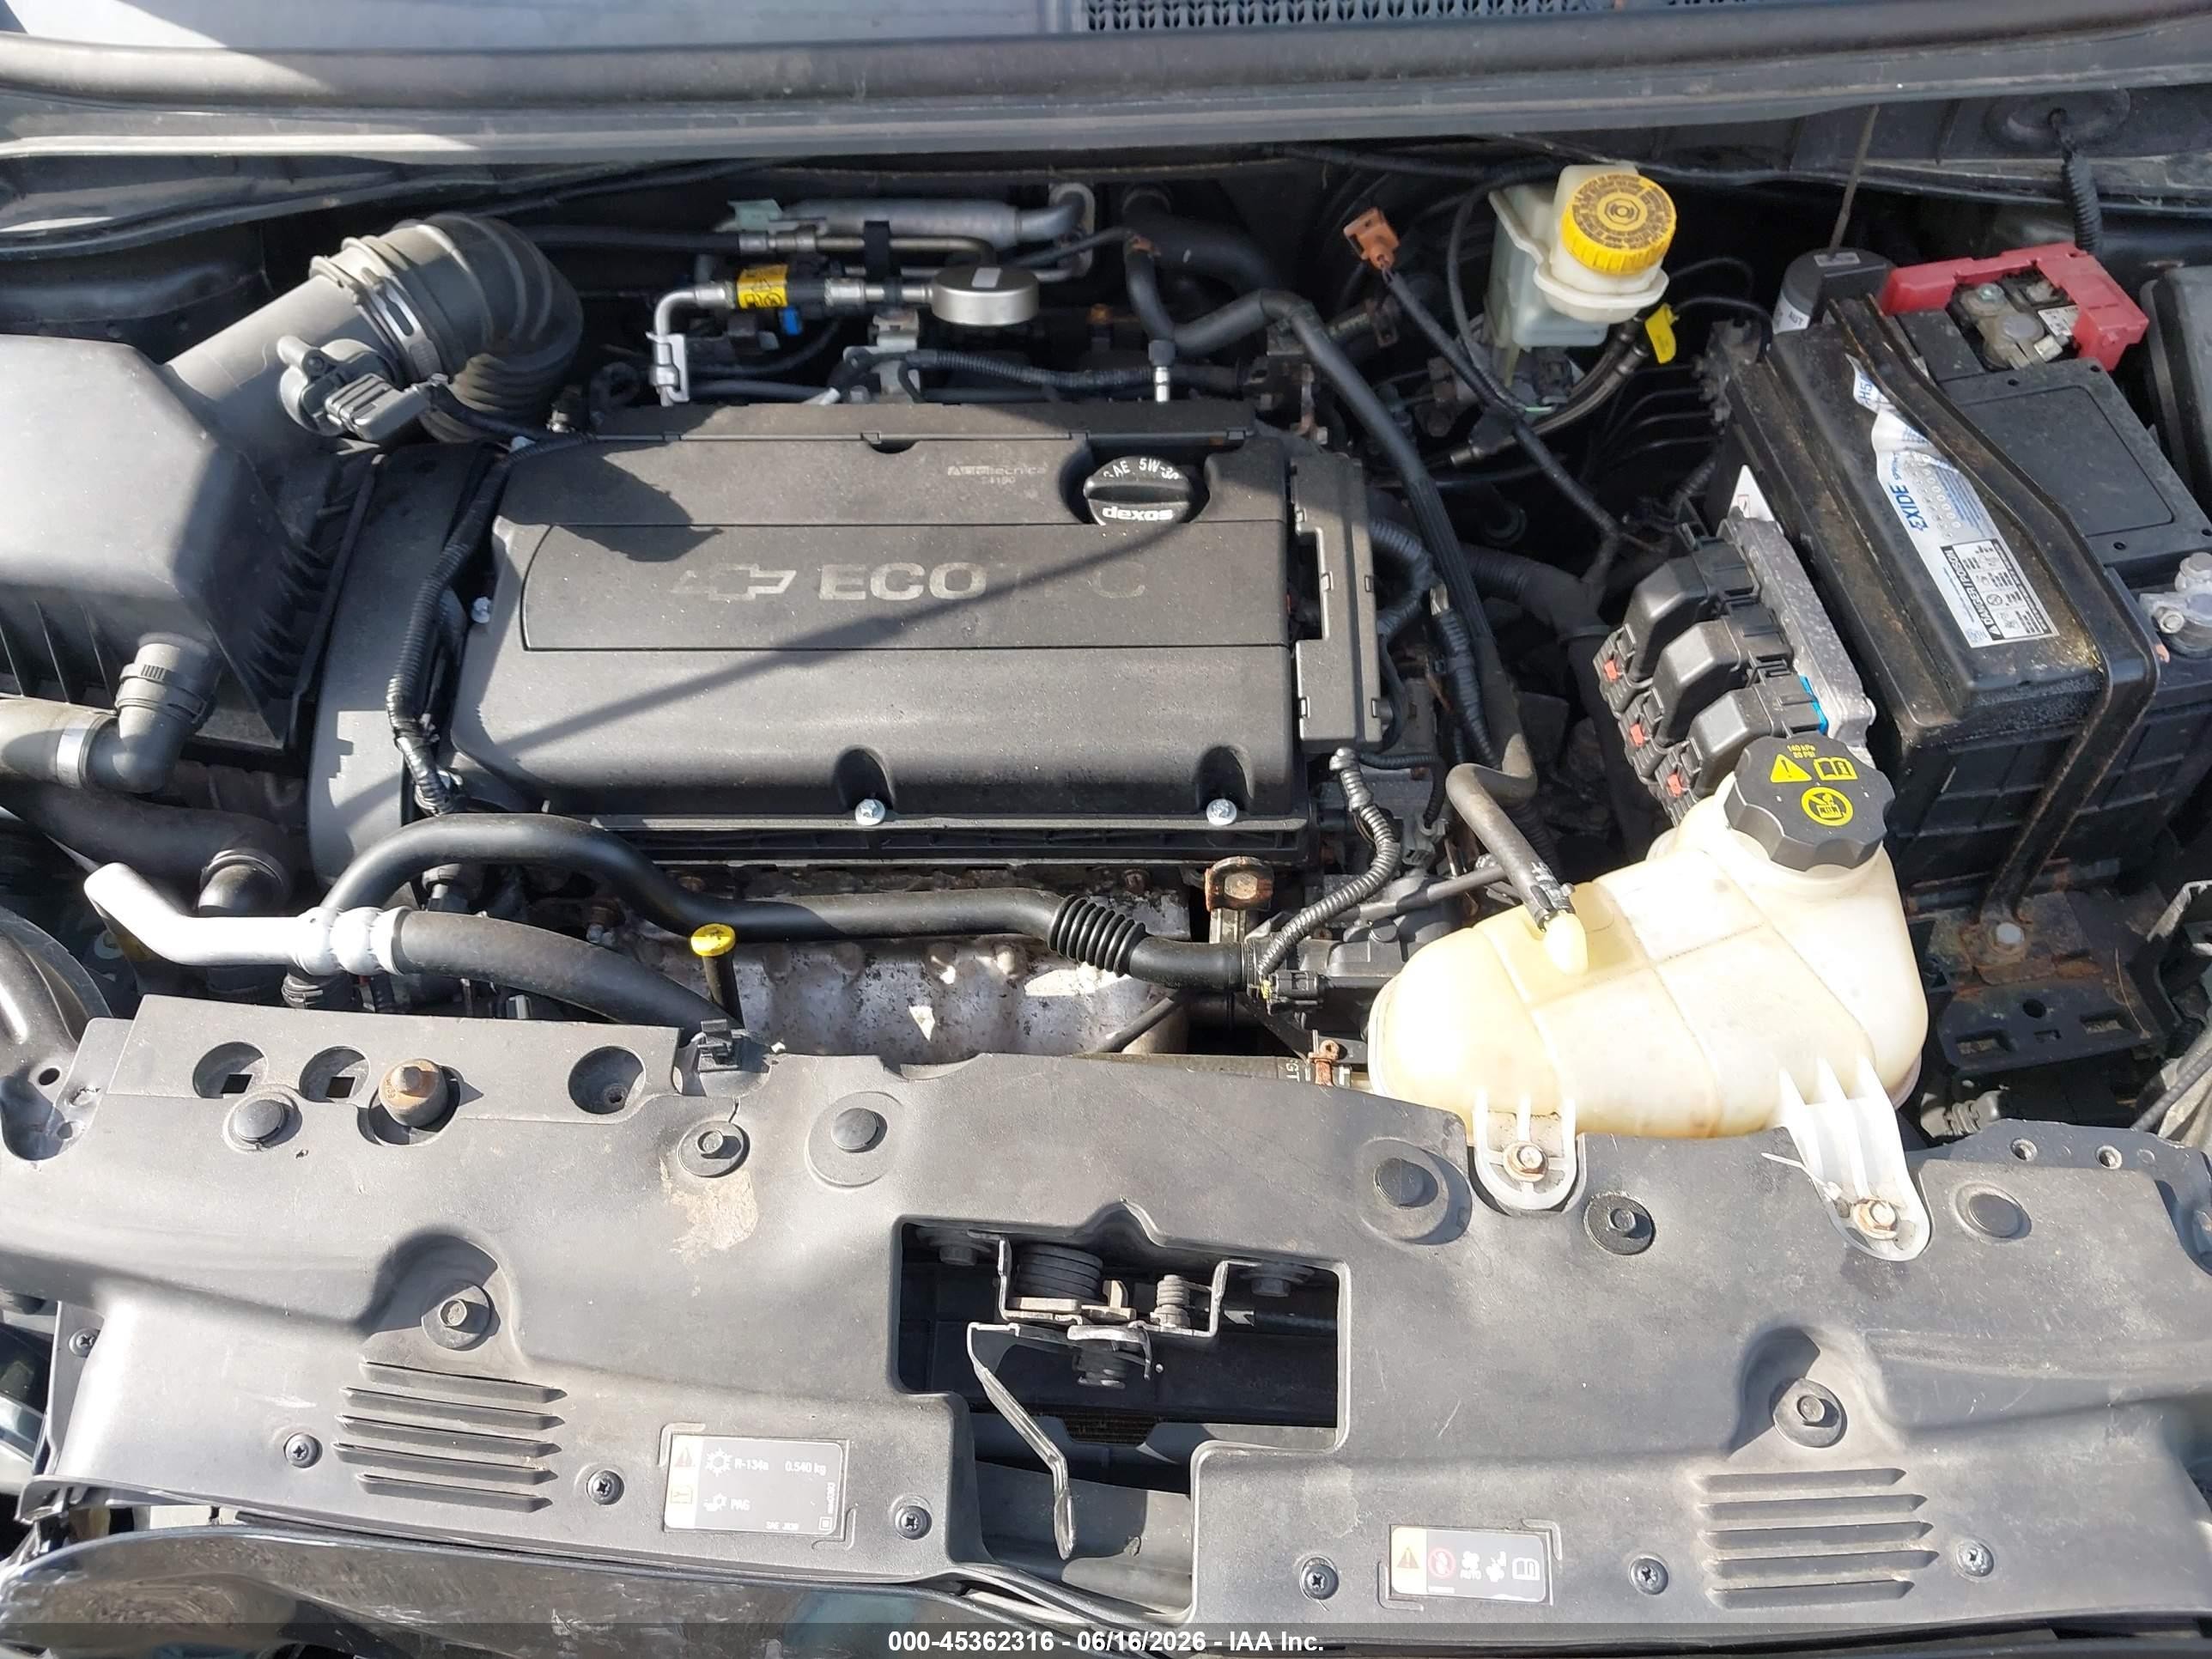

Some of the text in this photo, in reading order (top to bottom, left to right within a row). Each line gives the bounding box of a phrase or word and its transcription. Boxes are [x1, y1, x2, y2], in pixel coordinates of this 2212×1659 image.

[1102, 505, 1174, 521] dexos
[1889, 483, 1929, 532] EXIDE
[734, 1458, 827, 1476] R-134a 0.540 kg
[730, 1498, 751, 1511] PAG
